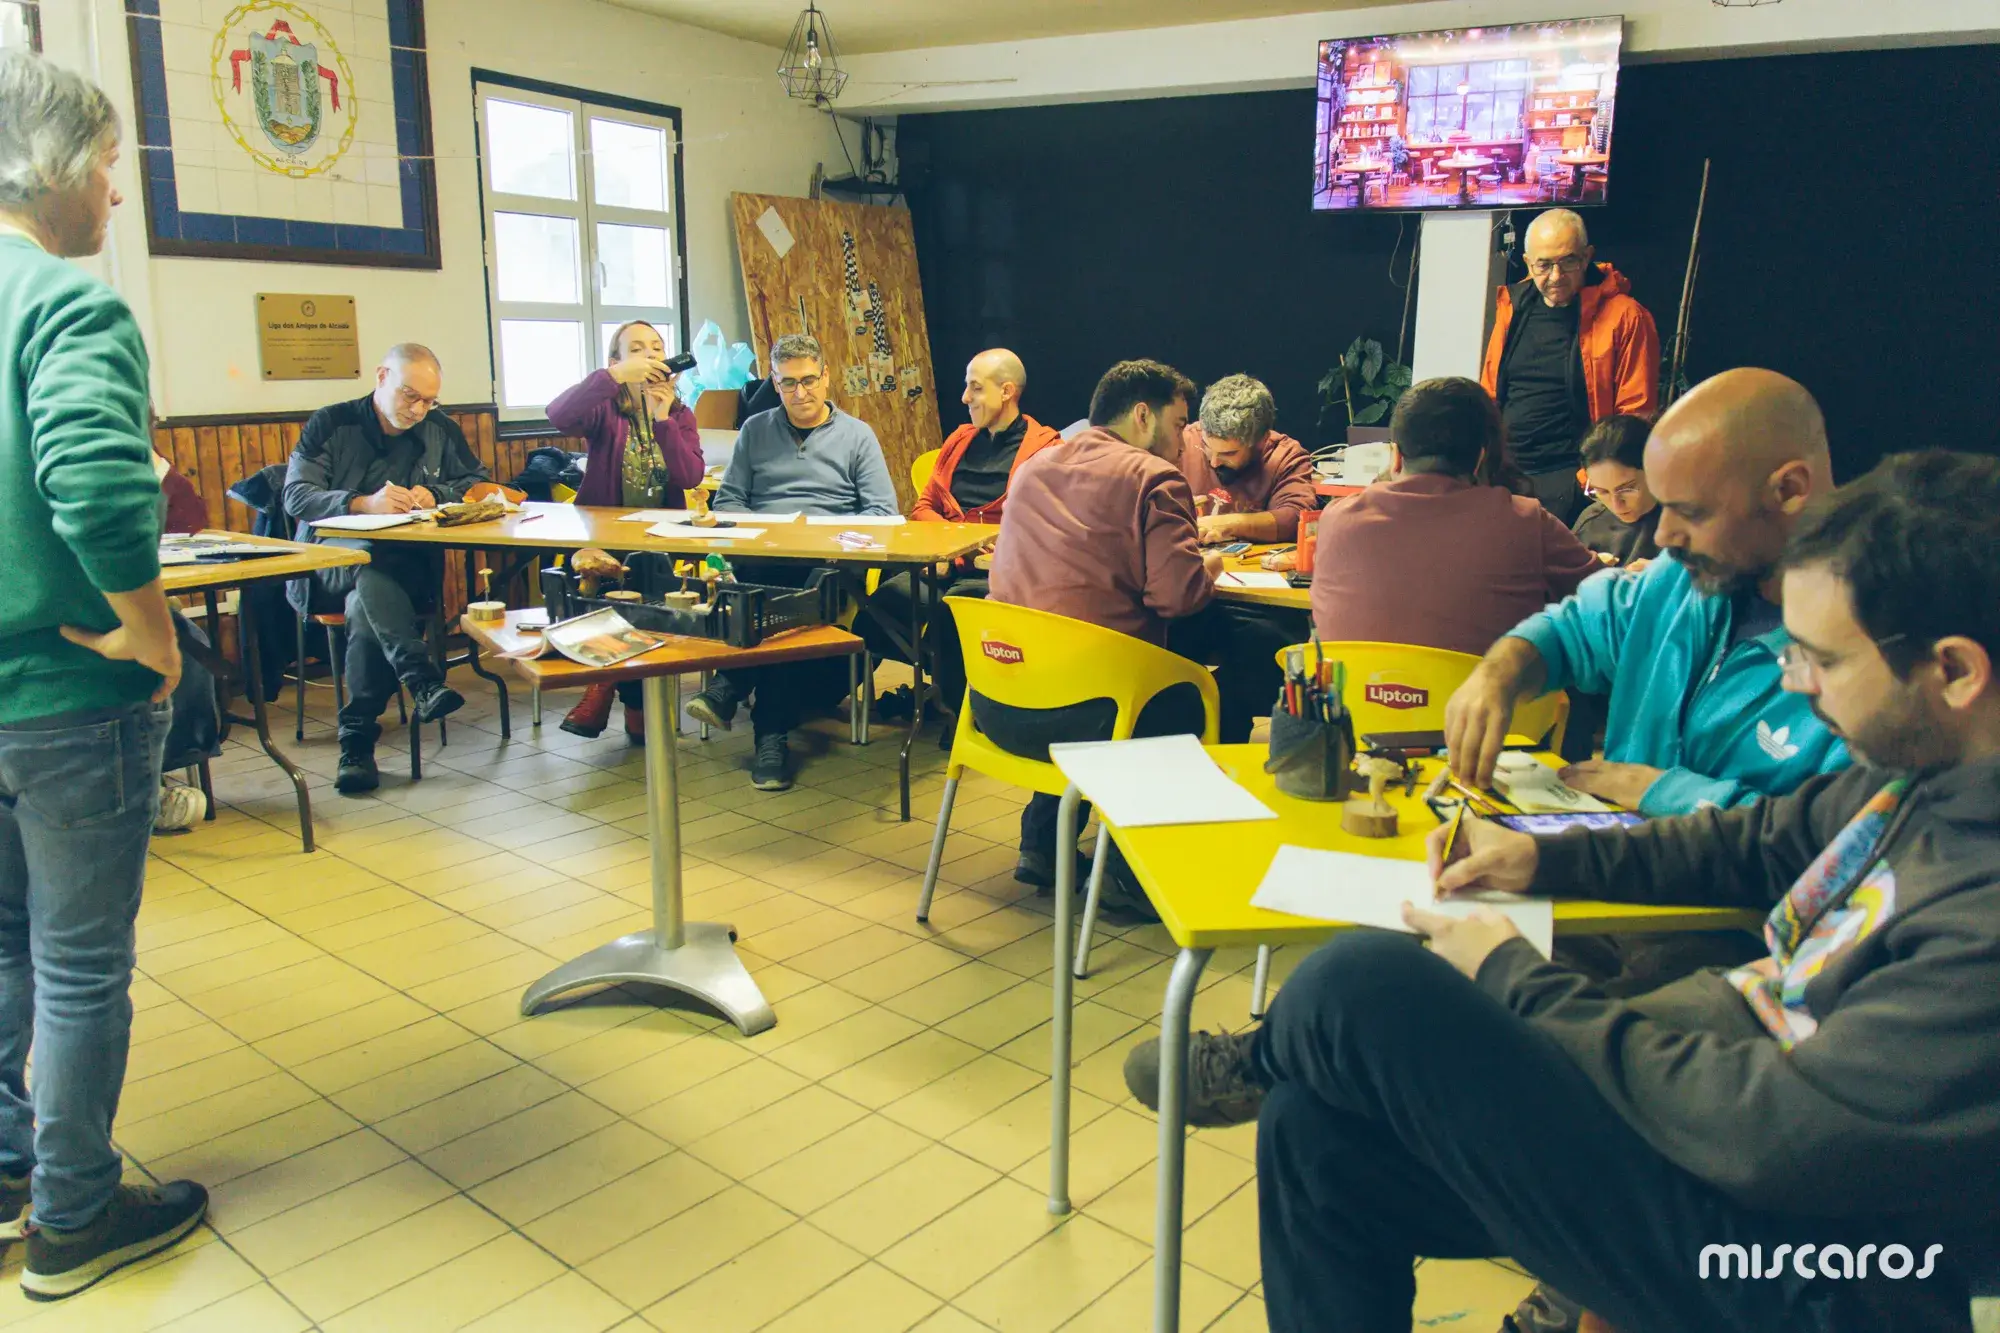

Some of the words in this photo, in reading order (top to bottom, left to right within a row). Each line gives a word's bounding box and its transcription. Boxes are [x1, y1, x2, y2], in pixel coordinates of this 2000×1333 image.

[268, 322, 281, 330] Liga
[296, 322, 318, 330] Amigos
[983, 643, 1020, 660] Lipton
[1369, 686, 1423, 704] Lipton
